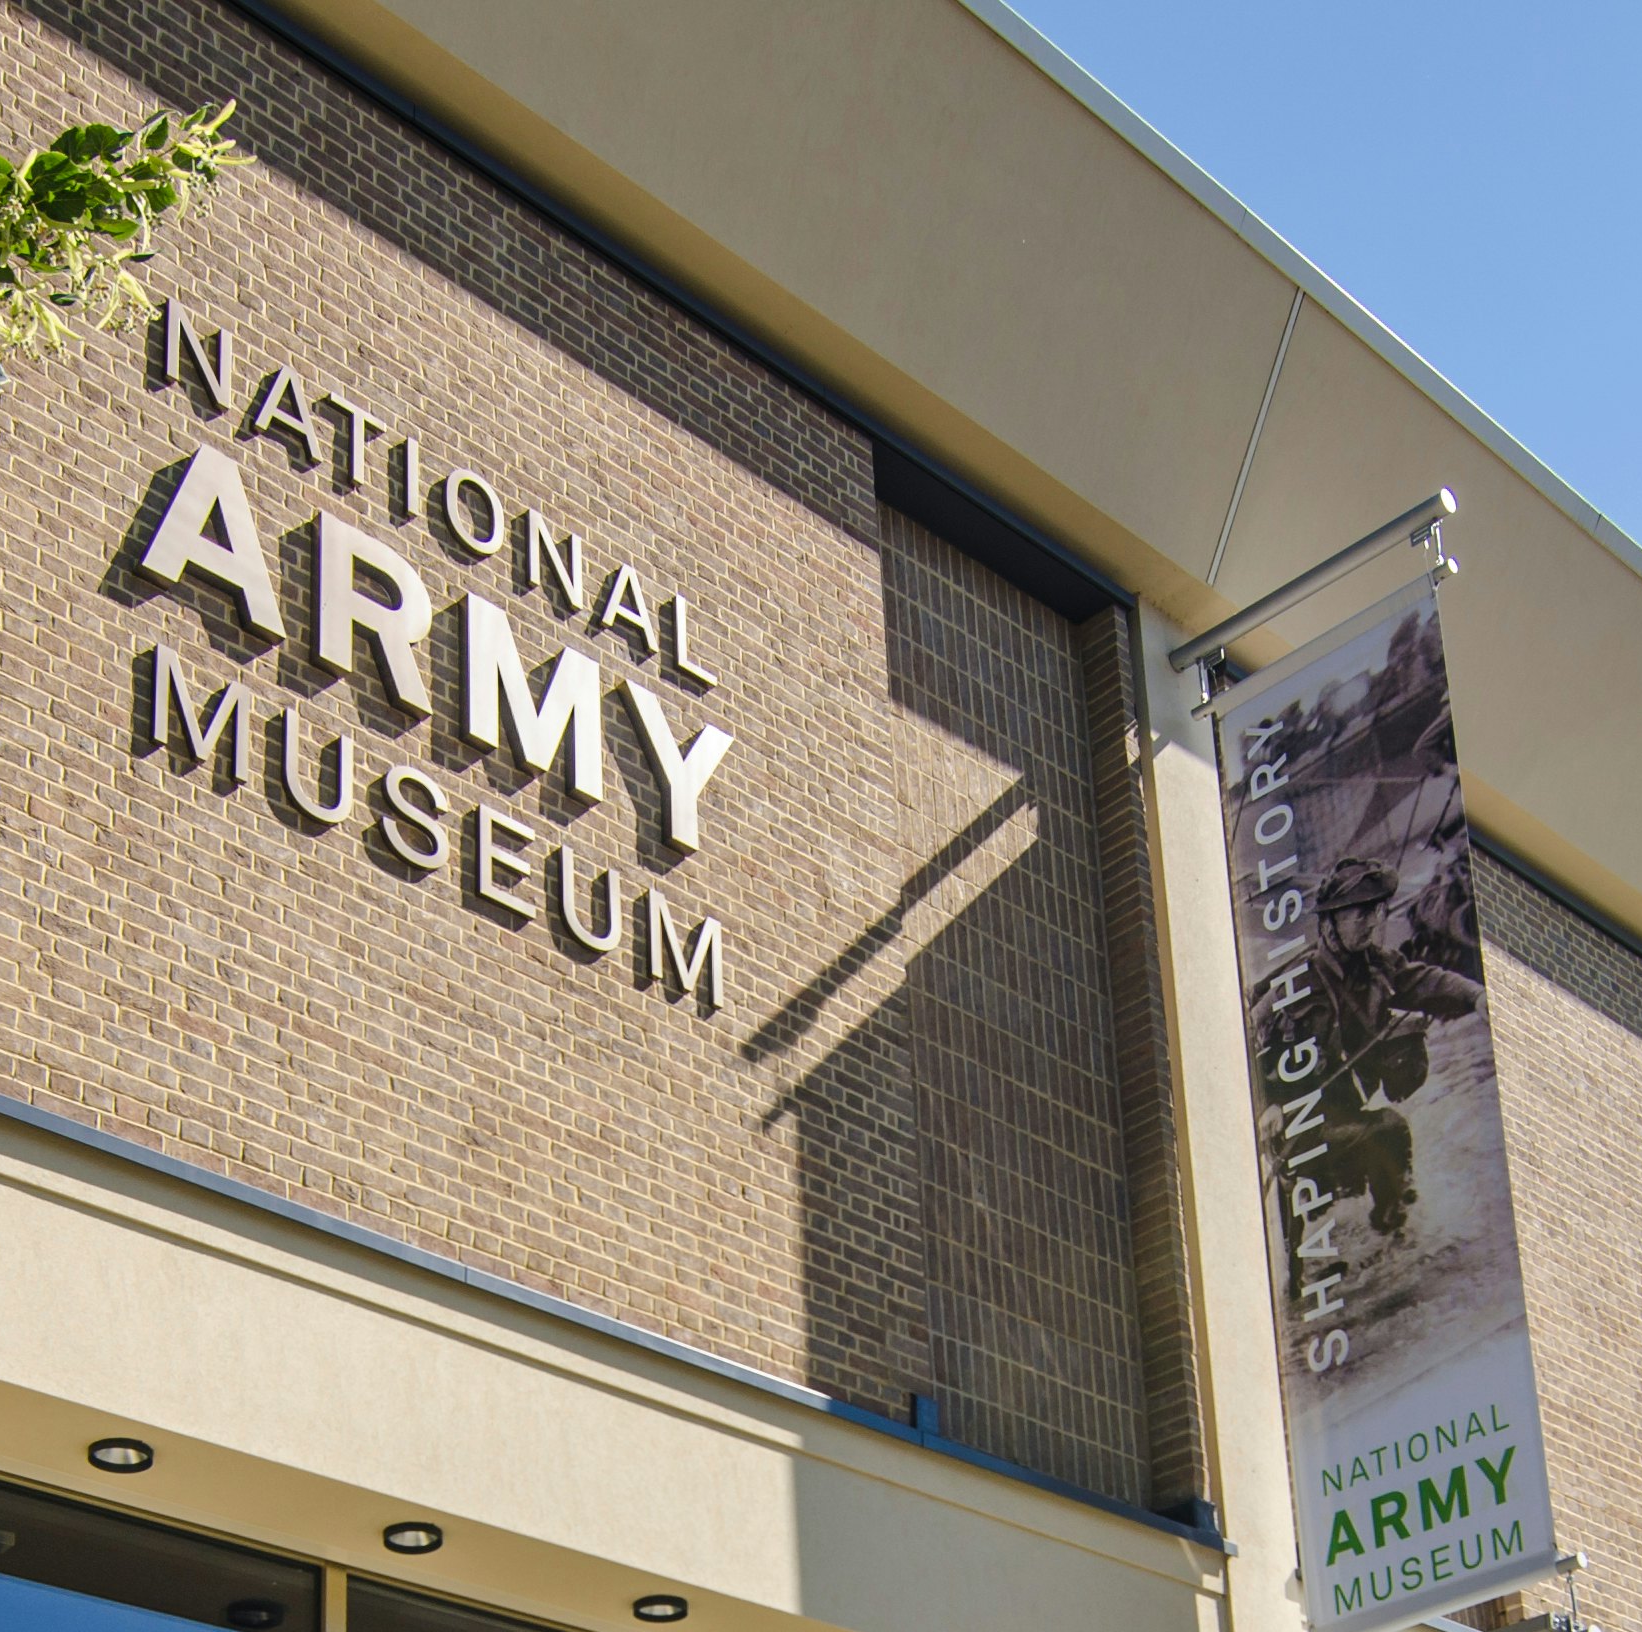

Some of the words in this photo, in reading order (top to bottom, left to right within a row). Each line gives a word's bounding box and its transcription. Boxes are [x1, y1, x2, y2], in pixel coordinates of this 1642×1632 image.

[135, 443, 734, 858] ARMY
[165, 299, 718, 688] NATIONAL
[153, 643, 724, 1011] MUSEUM
[1244, 720, 1312, 1012] HISTORY
[1278, 1036, 1350, 1373] SHAPING
[1321, 1404, 1510, 1497] NATIONAL
[1325, 1445, 1517, 1567] ARMY
[1333, 1519, 1524, 1616] MUSEUM
